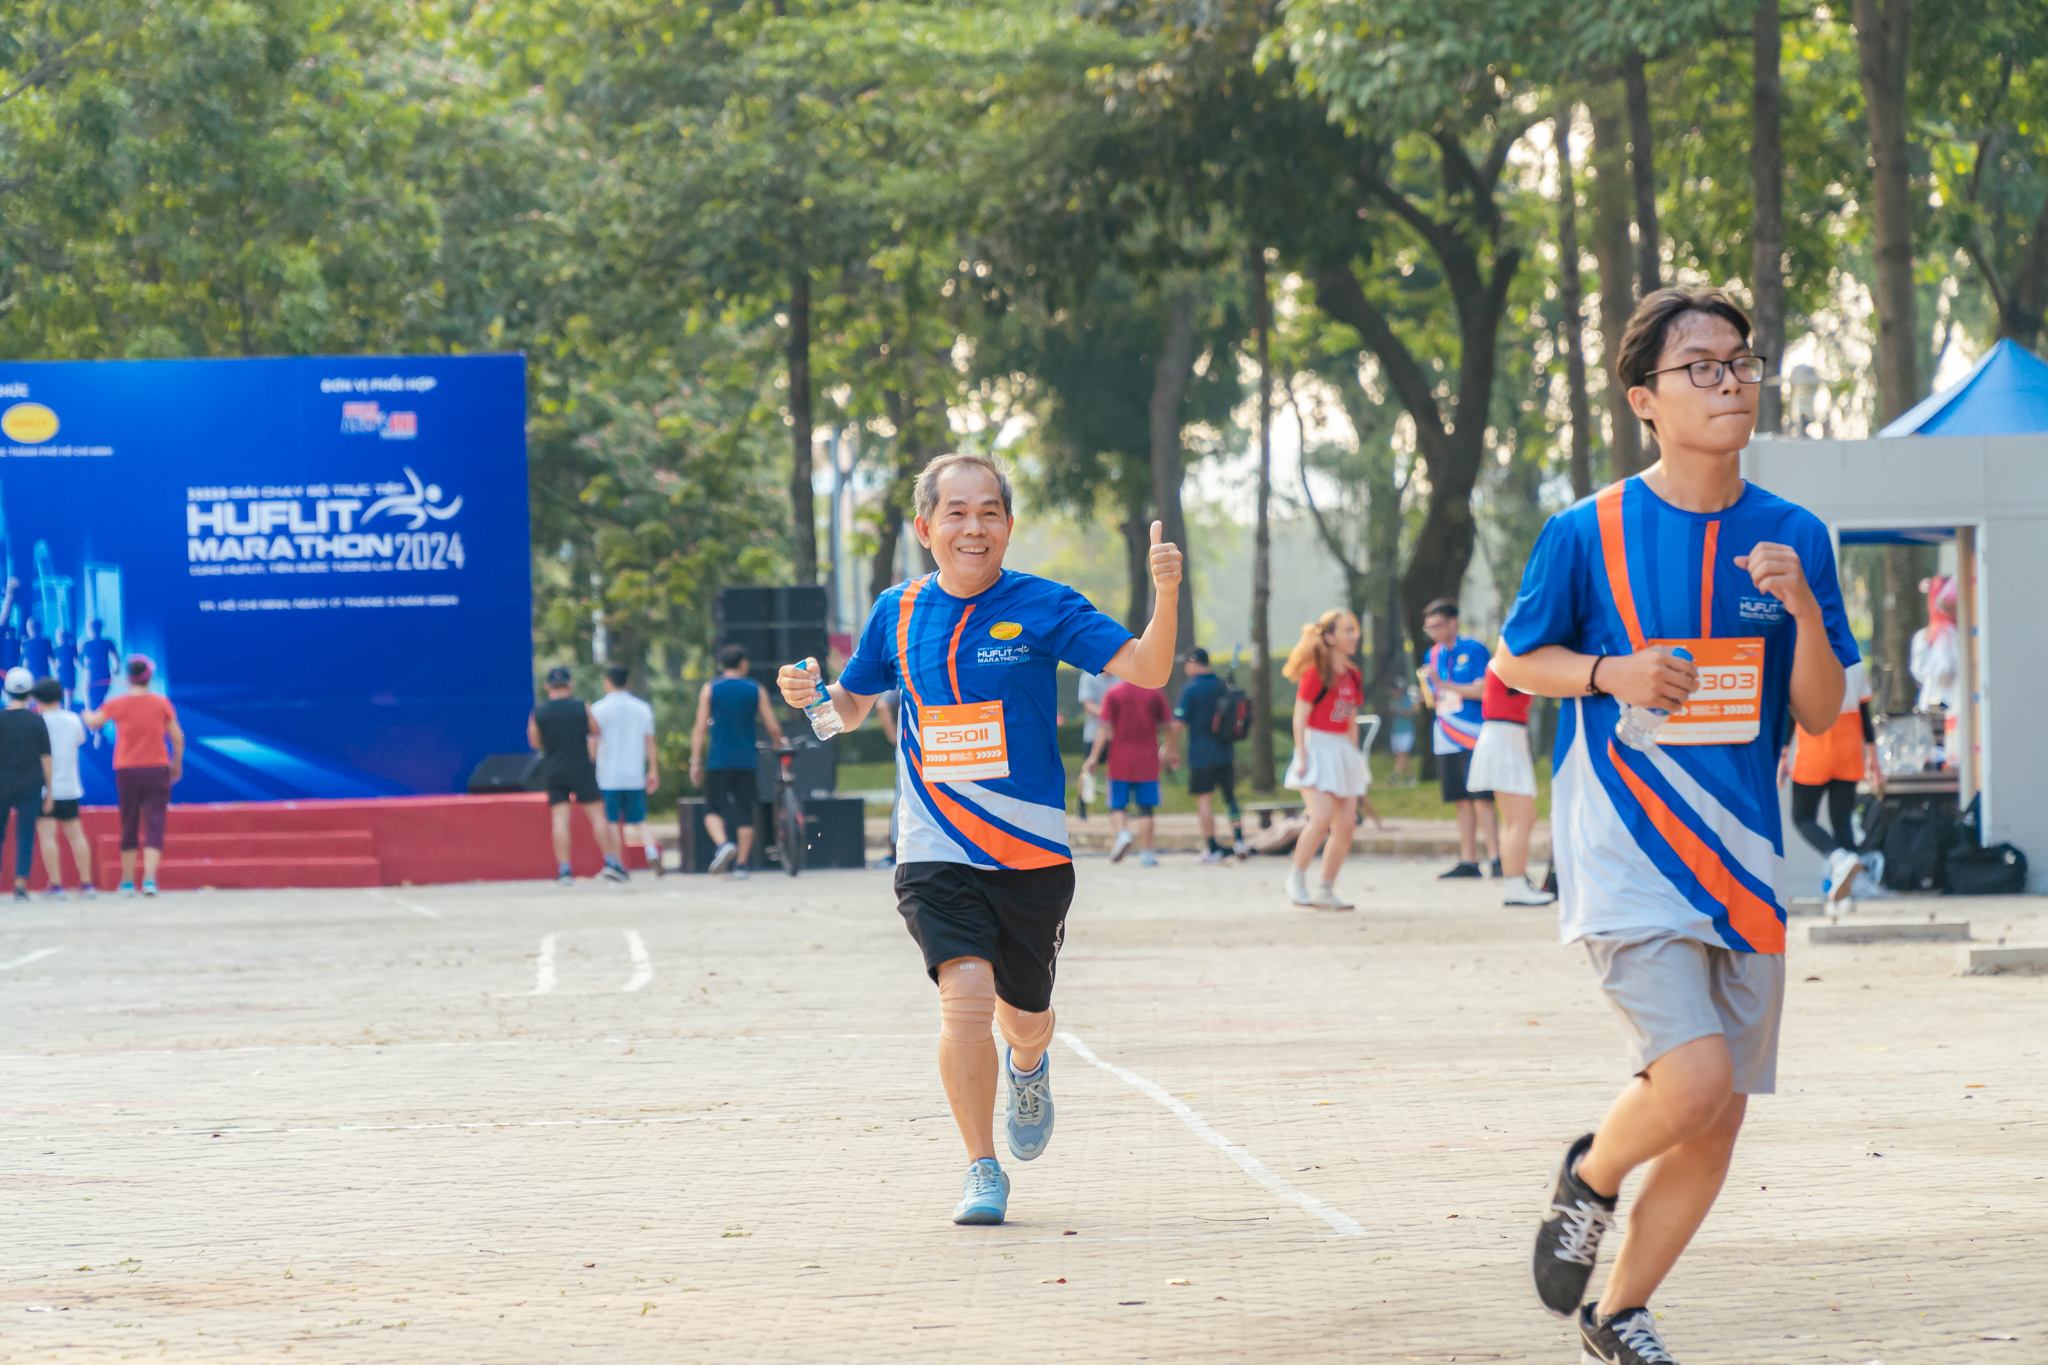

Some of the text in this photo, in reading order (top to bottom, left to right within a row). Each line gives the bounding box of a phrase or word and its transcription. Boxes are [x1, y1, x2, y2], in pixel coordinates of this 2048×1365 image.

[187, 499, 362, 536] HUFLIT
[187, 534, 393, 561] MARATHON
[394, 531, 465, 571] 2024
[977, 648, 1013, 658] HUFLIT
[977, 655, 1019, 663] MARATHON
[1701, 673, 1754, 690] 303
[935, 728, 989, 744] 25011
